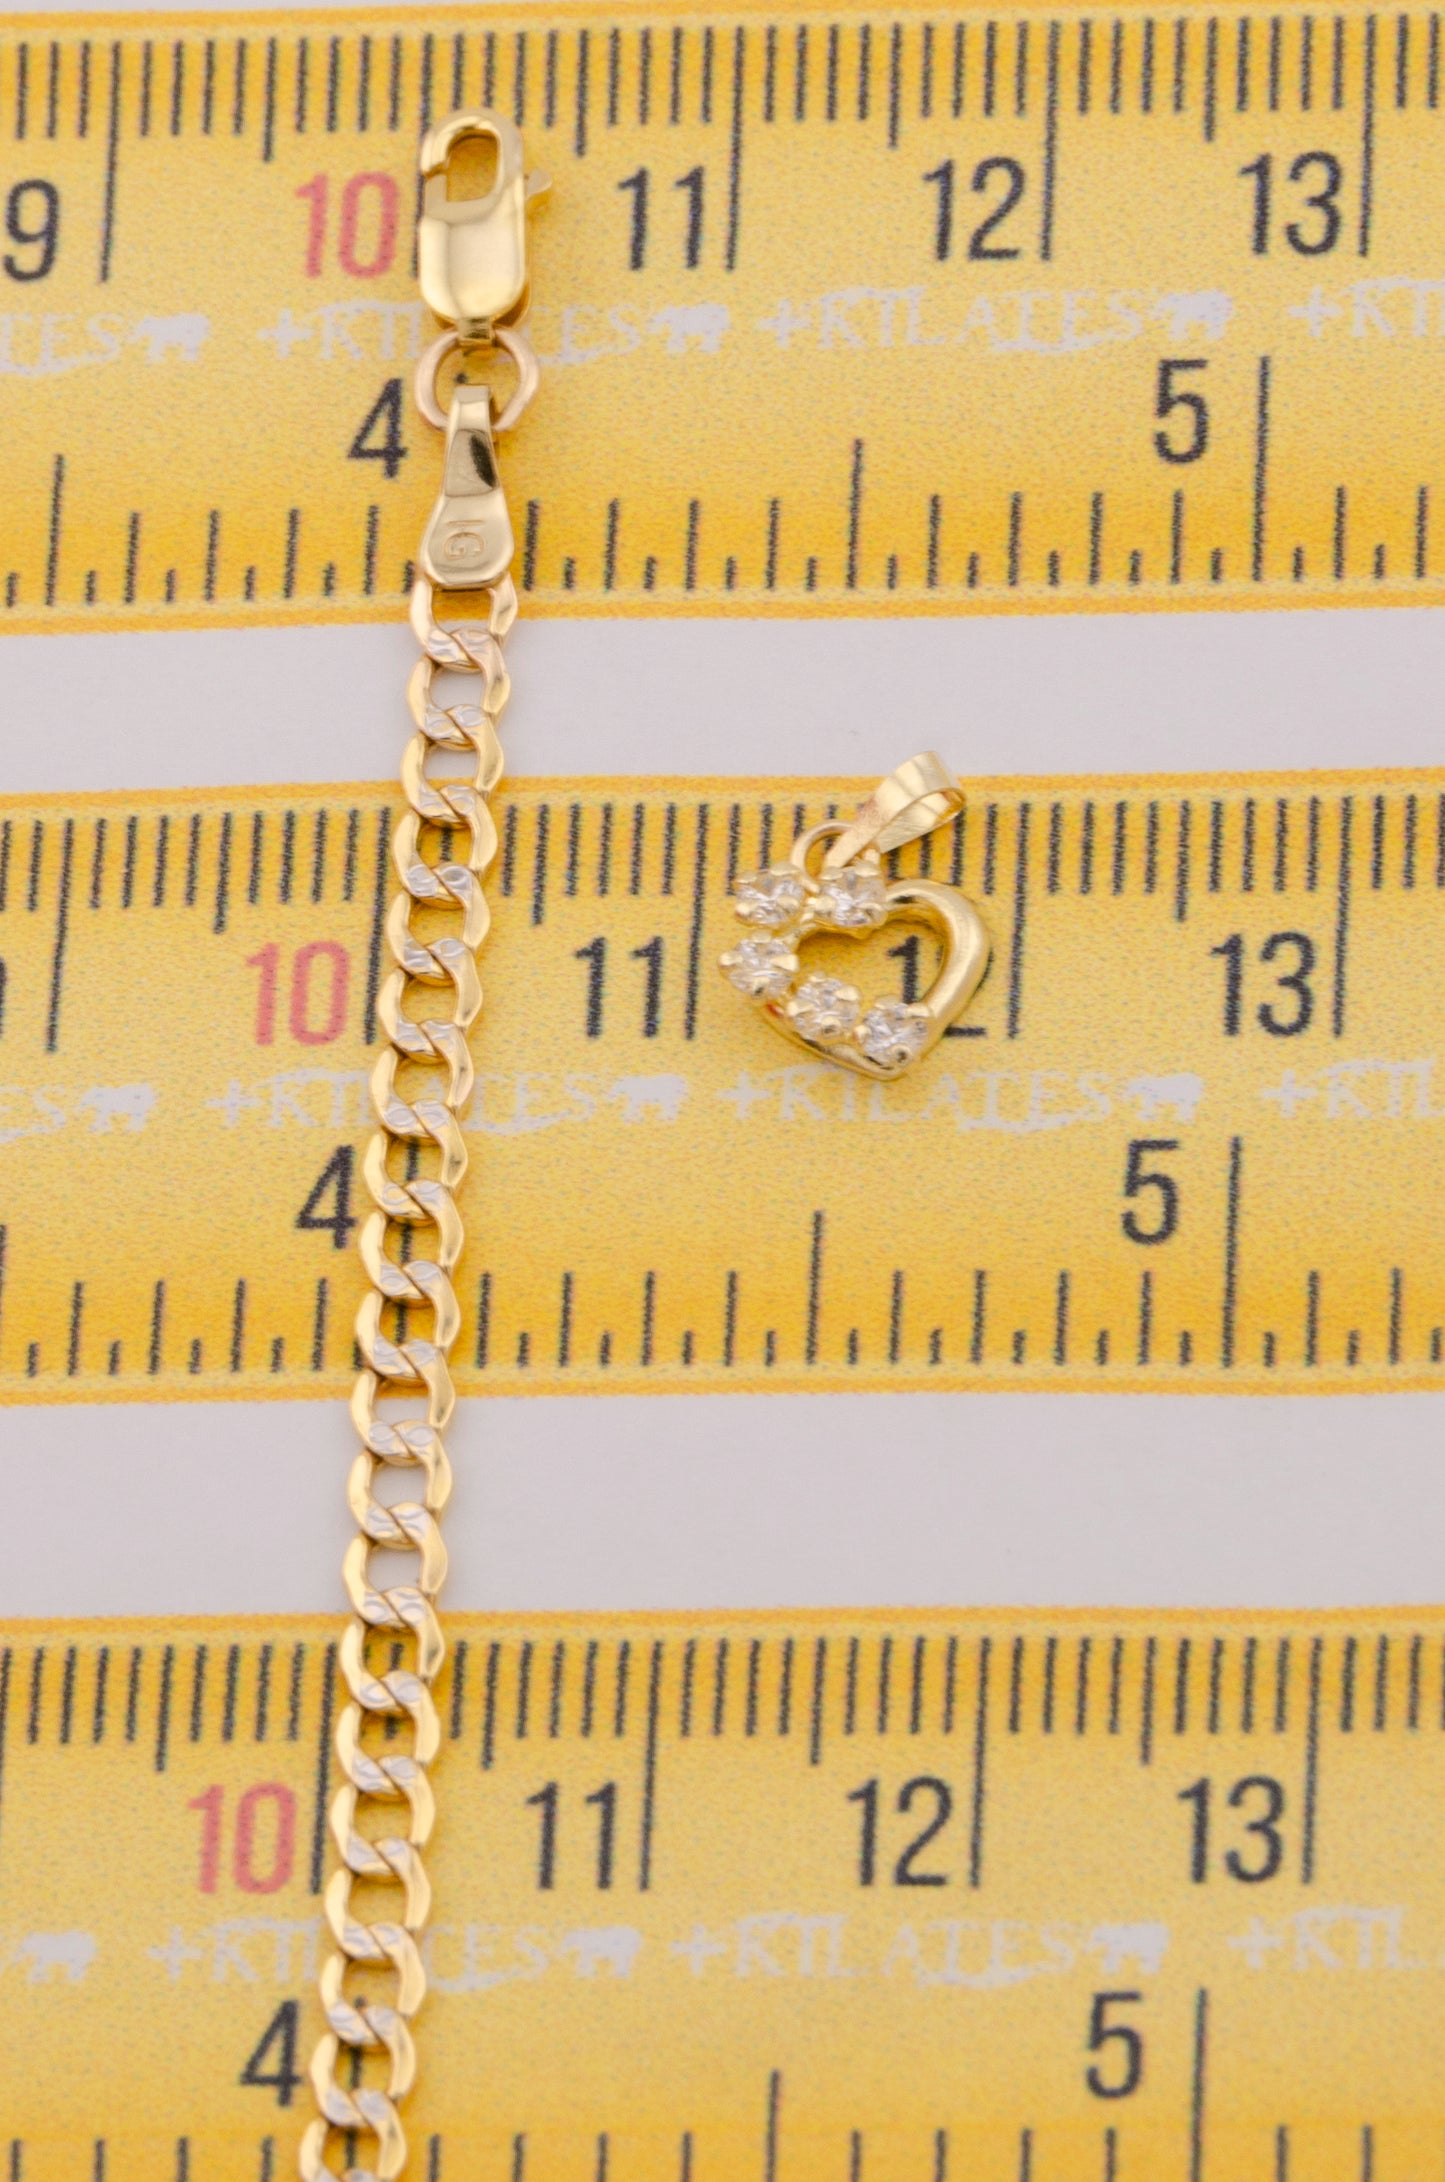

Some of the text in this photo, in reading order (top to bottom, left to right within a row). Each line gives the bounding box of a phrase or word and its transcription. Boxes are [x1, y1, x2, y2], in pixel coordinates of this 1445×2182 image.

[3, 151, 1344, 284] 9 10 11 12 13
[347, 359, 1210, 480] 4 5
[246, 941, 351, 1046] 10
[575, 936, 665, 1040] 11
[1210, 931, 1317, 1038] 13
[295, 1139, 1181, 1251] 4 5
[188, 1775, 1286, 1896] 10 11 12 13
[239, 1991, 1144, 2109] 4 5
